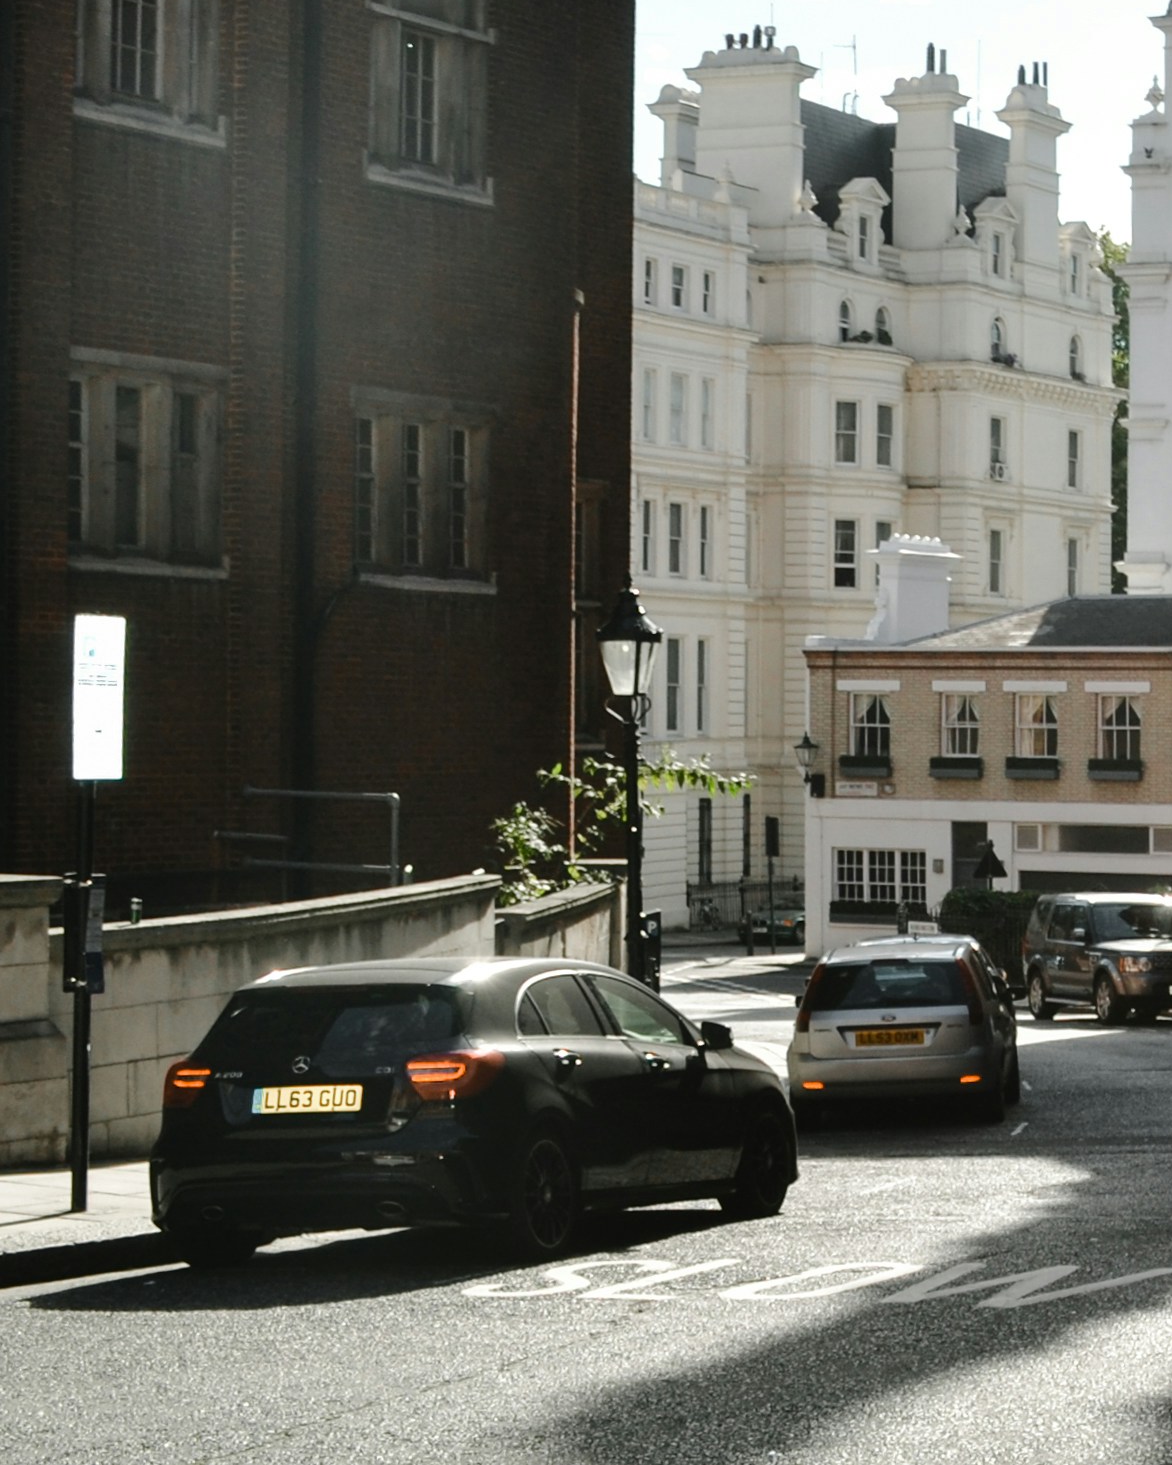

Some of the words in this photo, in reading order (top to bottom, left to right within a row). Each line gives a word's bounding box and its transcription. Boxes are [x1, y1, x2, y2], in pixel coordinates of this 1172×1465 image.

[647, 921, 657, 934] P
[264, 1089, 314, 1110] LL63
[319, 1088, 357, 1108] GUO
